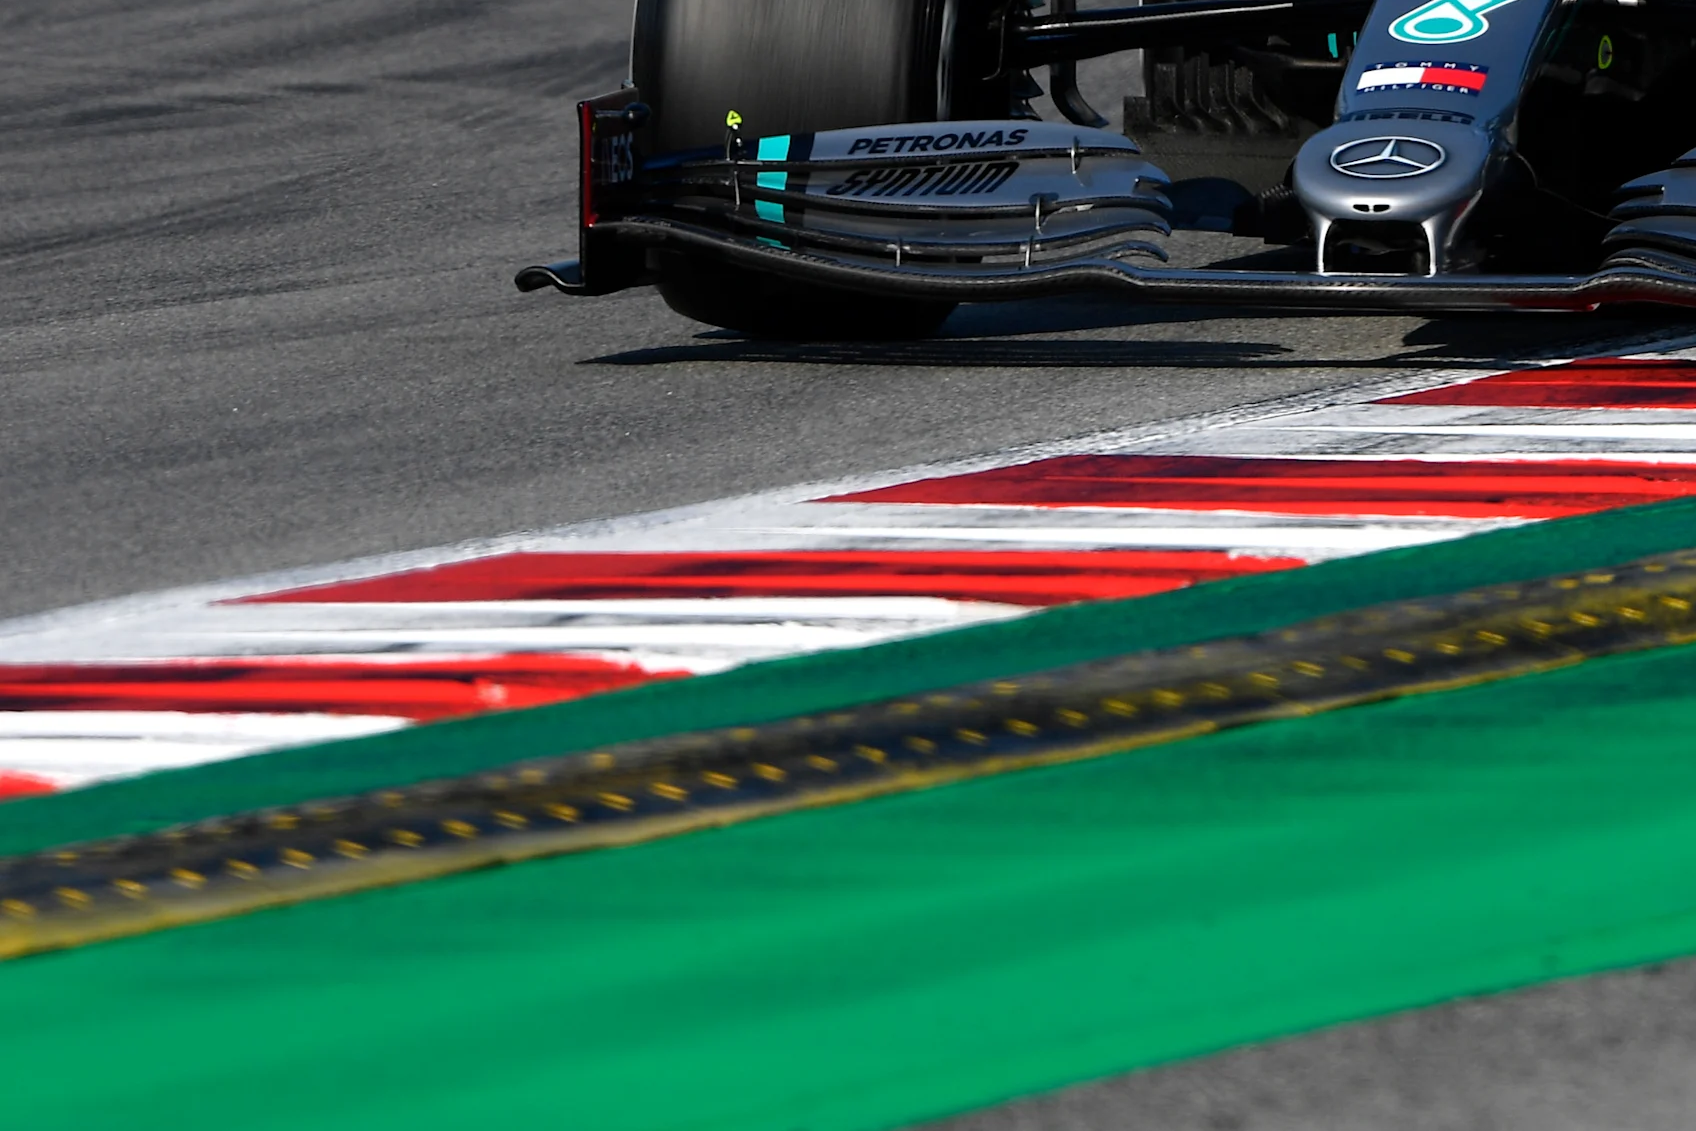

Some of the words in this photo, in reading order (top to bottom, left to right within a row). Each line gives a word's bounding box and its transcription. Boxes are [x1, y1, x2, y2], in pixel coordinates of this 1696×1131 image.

[1375, 61, 1479, 72] TOMMY
[1364, 83, 1469, 95] HILFIGER
[847, 128, 1029, 155] PETRONAS
[826, 161, 1020, 197] SYNTIUM
